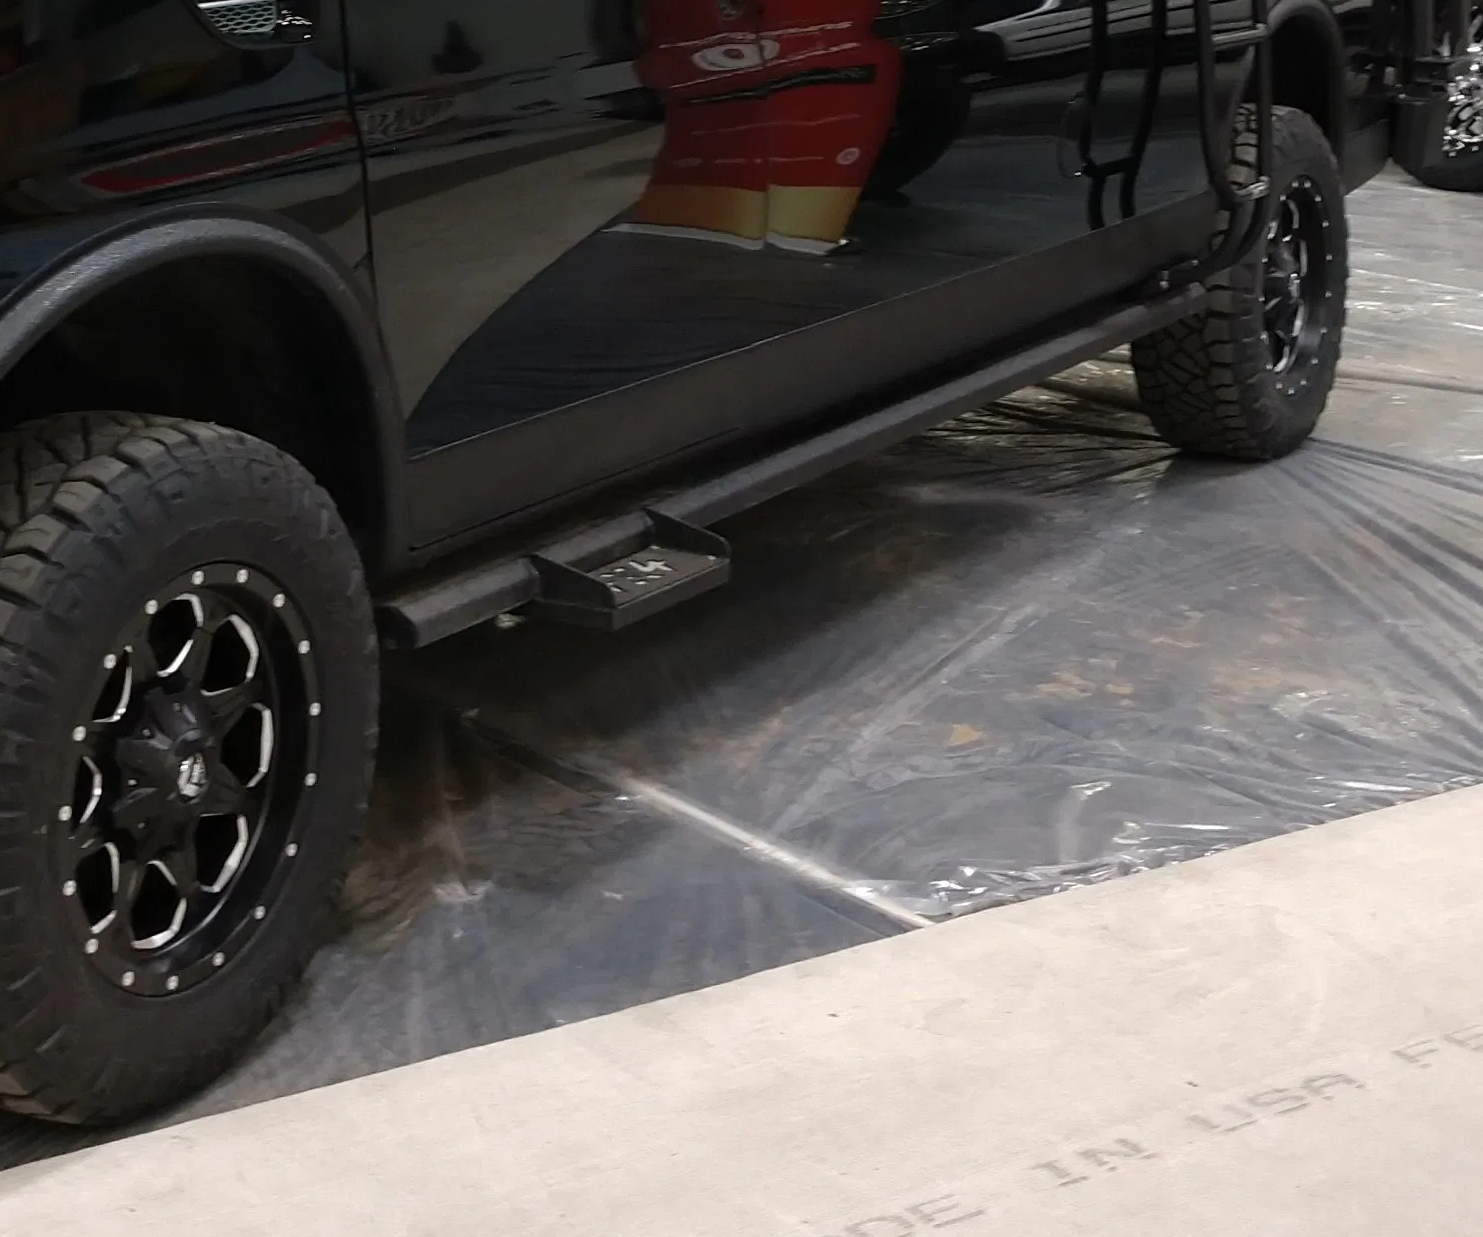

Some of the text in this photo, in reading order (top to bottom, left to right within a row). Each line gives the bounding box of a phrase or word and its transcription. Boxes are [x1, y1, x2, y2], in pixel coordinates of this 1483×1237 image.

[822, 1192, 987, 1237] DE
[1028, 1137, 1161, 1187] IN
[1185, 1073, 1367, 1133] USA
